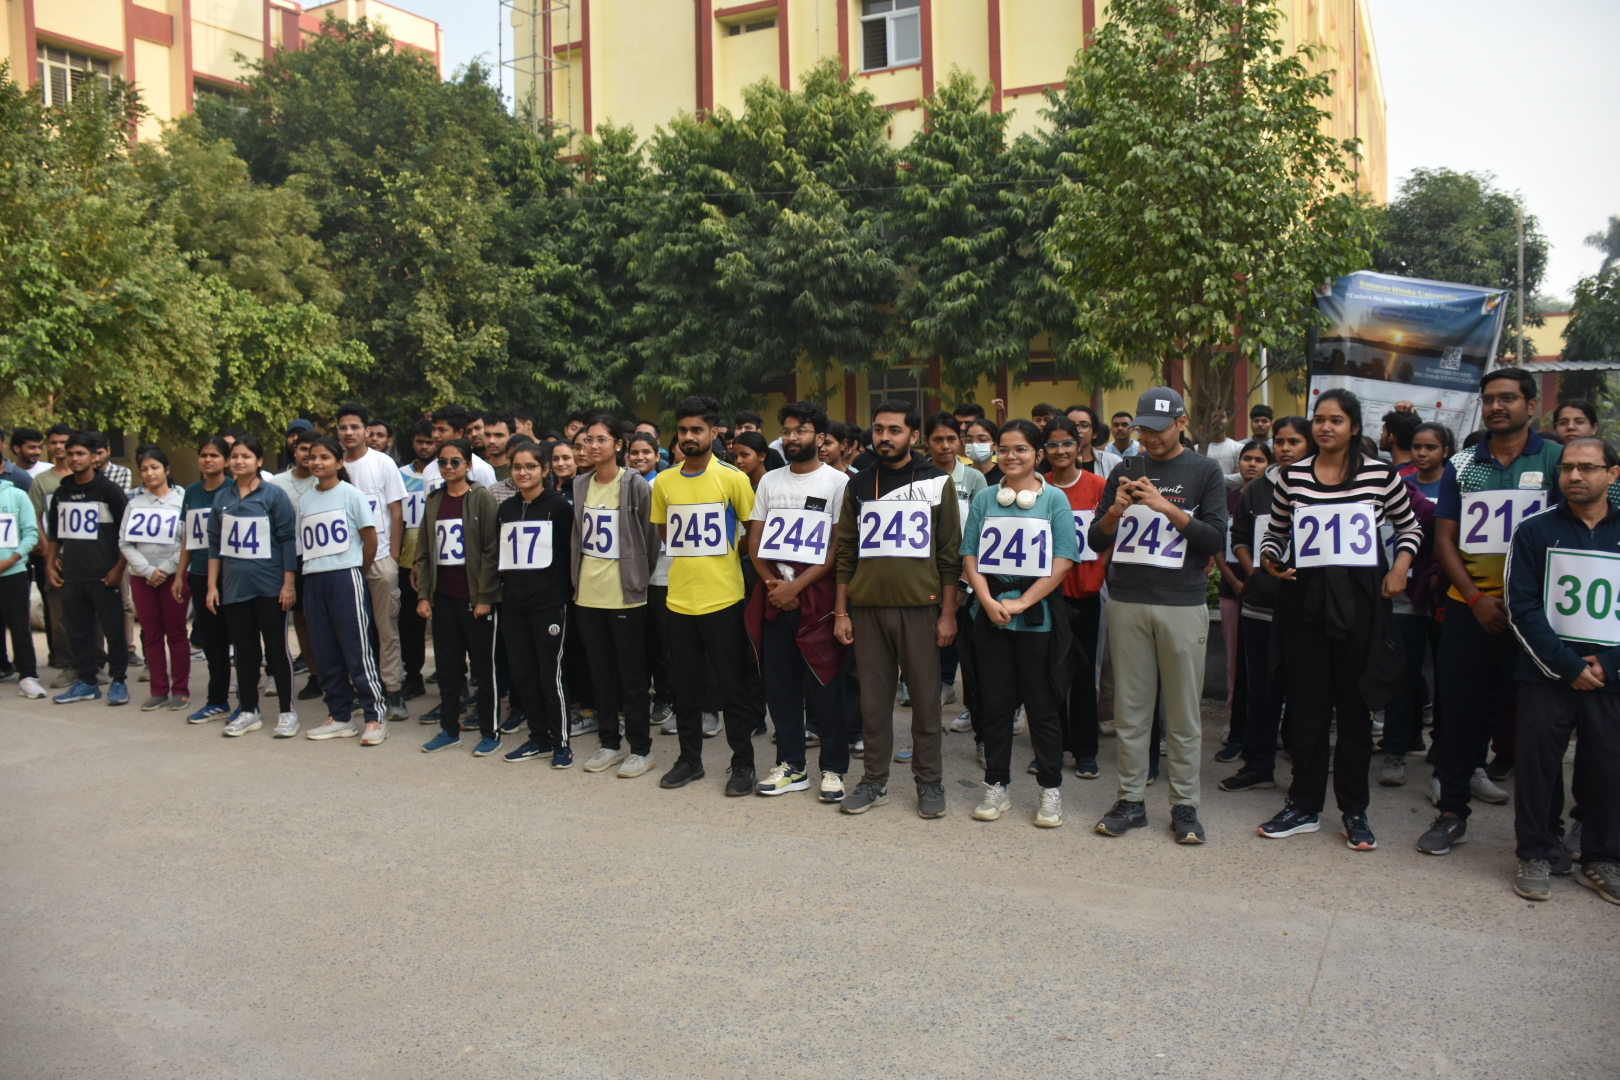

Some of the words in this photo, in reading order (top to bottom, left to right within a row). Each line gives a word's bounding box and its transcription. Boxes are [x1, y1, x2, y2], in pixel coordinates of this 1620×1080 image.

[890, 487, 927, 501] TION
[60, 508, 99, 533] 108
[129, 513, 176, 538] 201
[228, 521, 259, 555] 44
[303, 519, 348, 550] 006
[582, 511, 612, 553] 25
[671, 511, 722, 547] 245
[763, 516, 825, 555] 244
[861, 511, 929, 549] 243
[1116, 517, 1185, 558] 242
[1299, 513, 1372, 557] 213
[437, 523, 466, 560] 23
[507, 526, 541, 565] 17
[979, 527, 1047, 569] 241
[1555, 574, 1620, 621] 30
